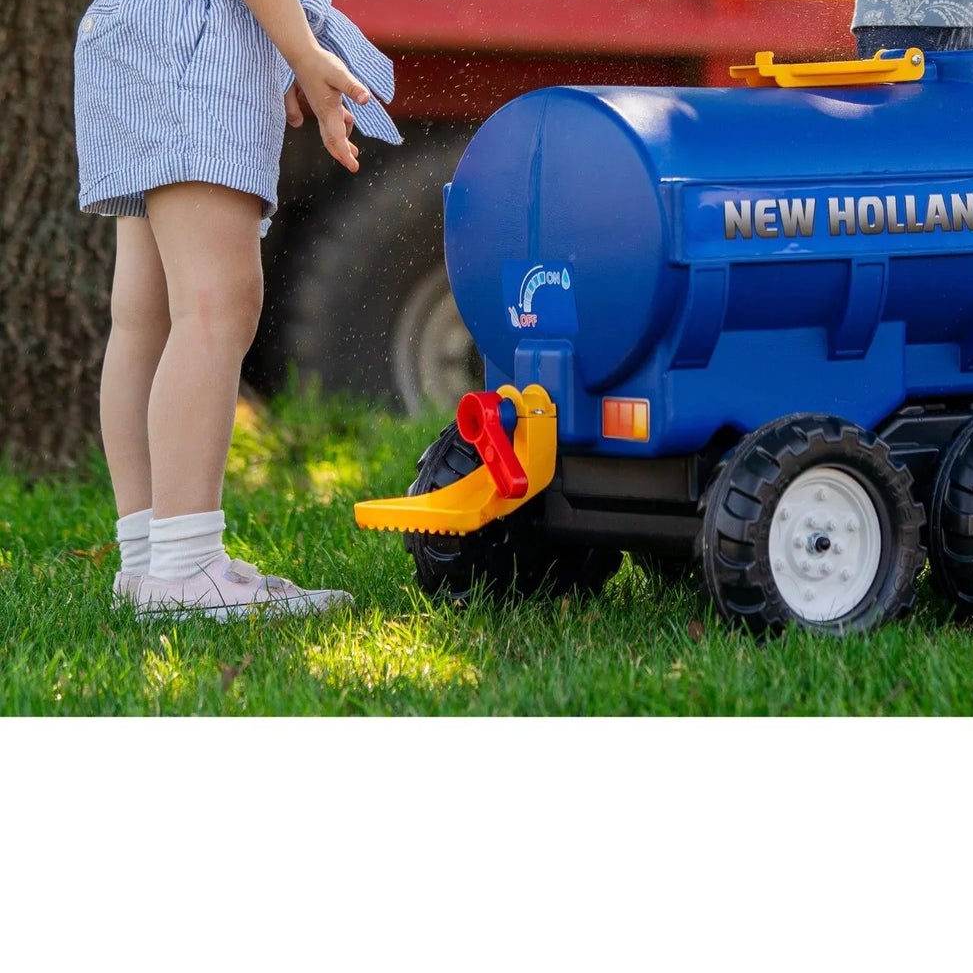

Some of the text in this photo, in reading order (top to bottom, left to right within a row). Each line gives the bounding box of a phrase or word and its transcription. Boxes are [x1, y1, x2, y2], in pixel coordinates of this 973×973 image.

[724, 197, 816, 240] NEW
[546, 271, 560, 285] ON
[520, 314, 538, 328] OFF
